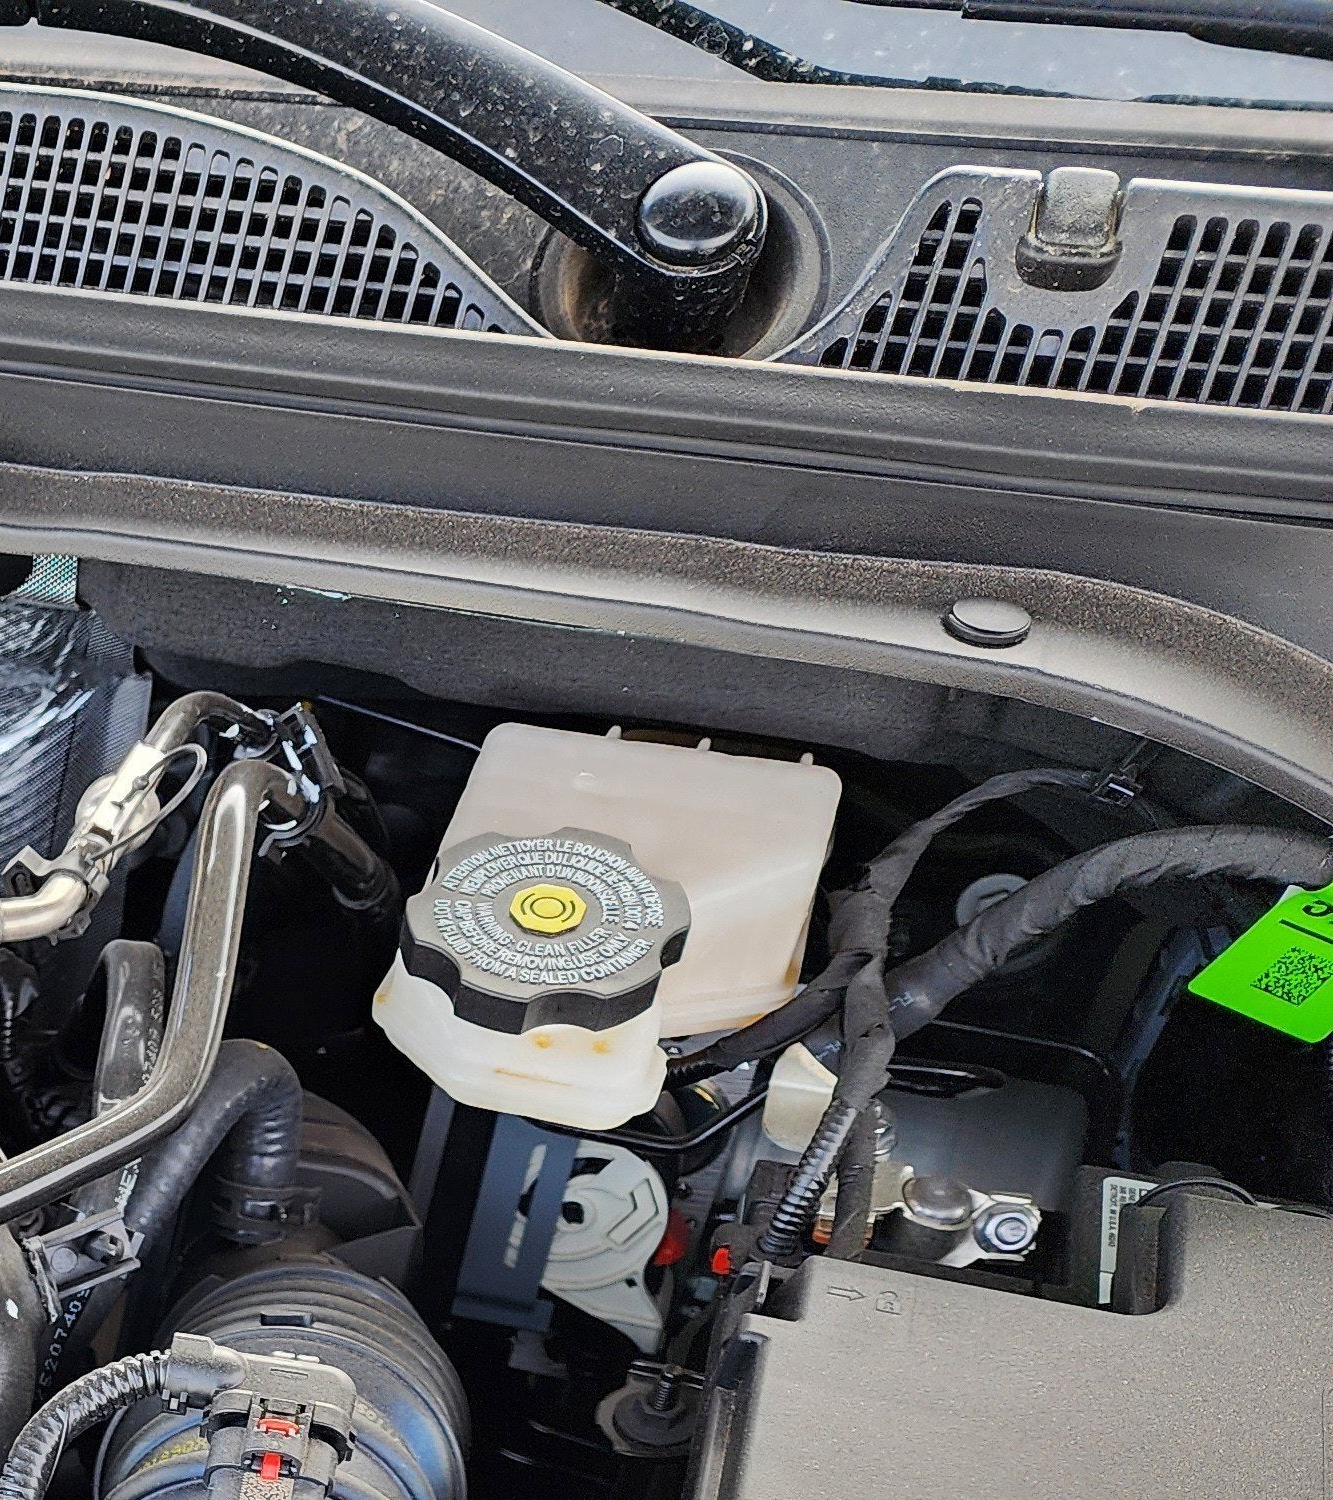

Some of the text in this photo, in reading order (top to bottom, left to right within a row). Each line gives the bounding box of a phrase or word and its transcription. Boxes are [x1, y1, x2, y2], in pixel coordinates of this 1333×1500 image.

[480, 864, 545, 899] PROVENANT
[571, 869, 609, 897] BIDON
[488, 838, 554, 858] NETTOYER
[555, 838, 574, 852] LE
[573, 841, 630, 872] BOUCHON
[621, 865, 657, 893] AVANT
[516, 851, 545, 865] QUE
[545, 851, 563, 864] DU
[562, 852, 611, 878] LIQUIDE
[601, 869, 625, 886] DE
[453, 899, 474, 921] CAP
[438, 923, 473, 955] FLUID
[464, 949, 508, 977] FROM
[504, 966, 517, 981] A
[517, 967, 579, 985] SEALED
[458, 919, 503, 958] BEFORE
[516, 940, 567, 957] CLEAN
[566, 927, 613, 954] FILLER
[598, 931, 631, 958] ONLY
[572, 951, 601, 968] USE
